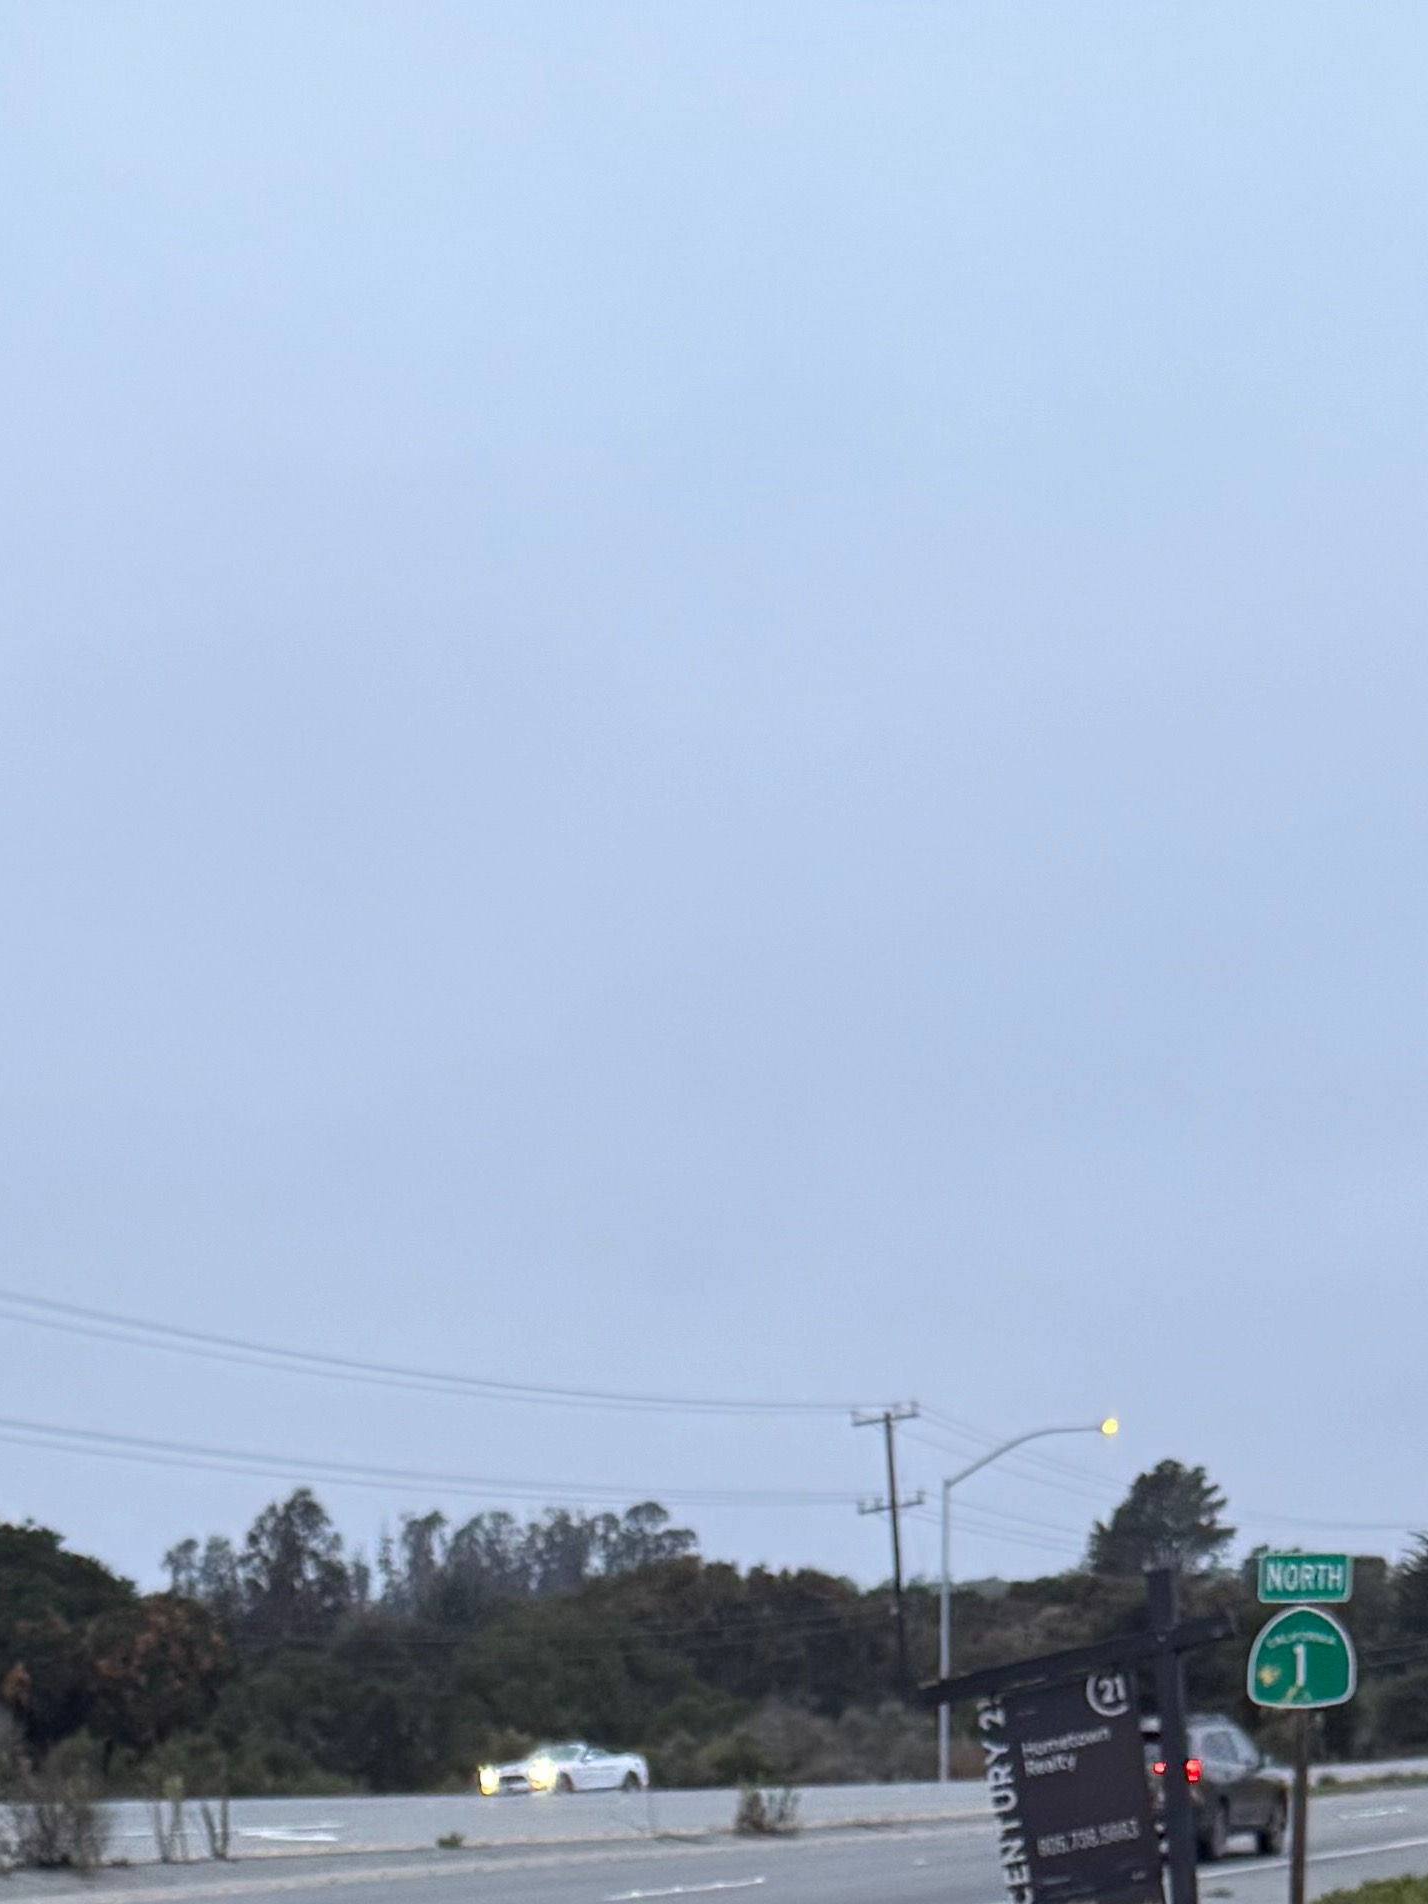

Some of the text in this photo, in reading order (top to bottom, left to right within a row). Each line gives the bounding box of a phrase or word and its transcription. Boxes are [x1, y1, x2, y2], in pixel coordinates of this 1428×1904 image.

[1265, 1563, 1343, 1592] NORTH
[1292, 1643, 1306, 1688] 1
[1022, 1726, 1112, 1758] Hometown
[1024, 1753, 1078, 1778] Realty
